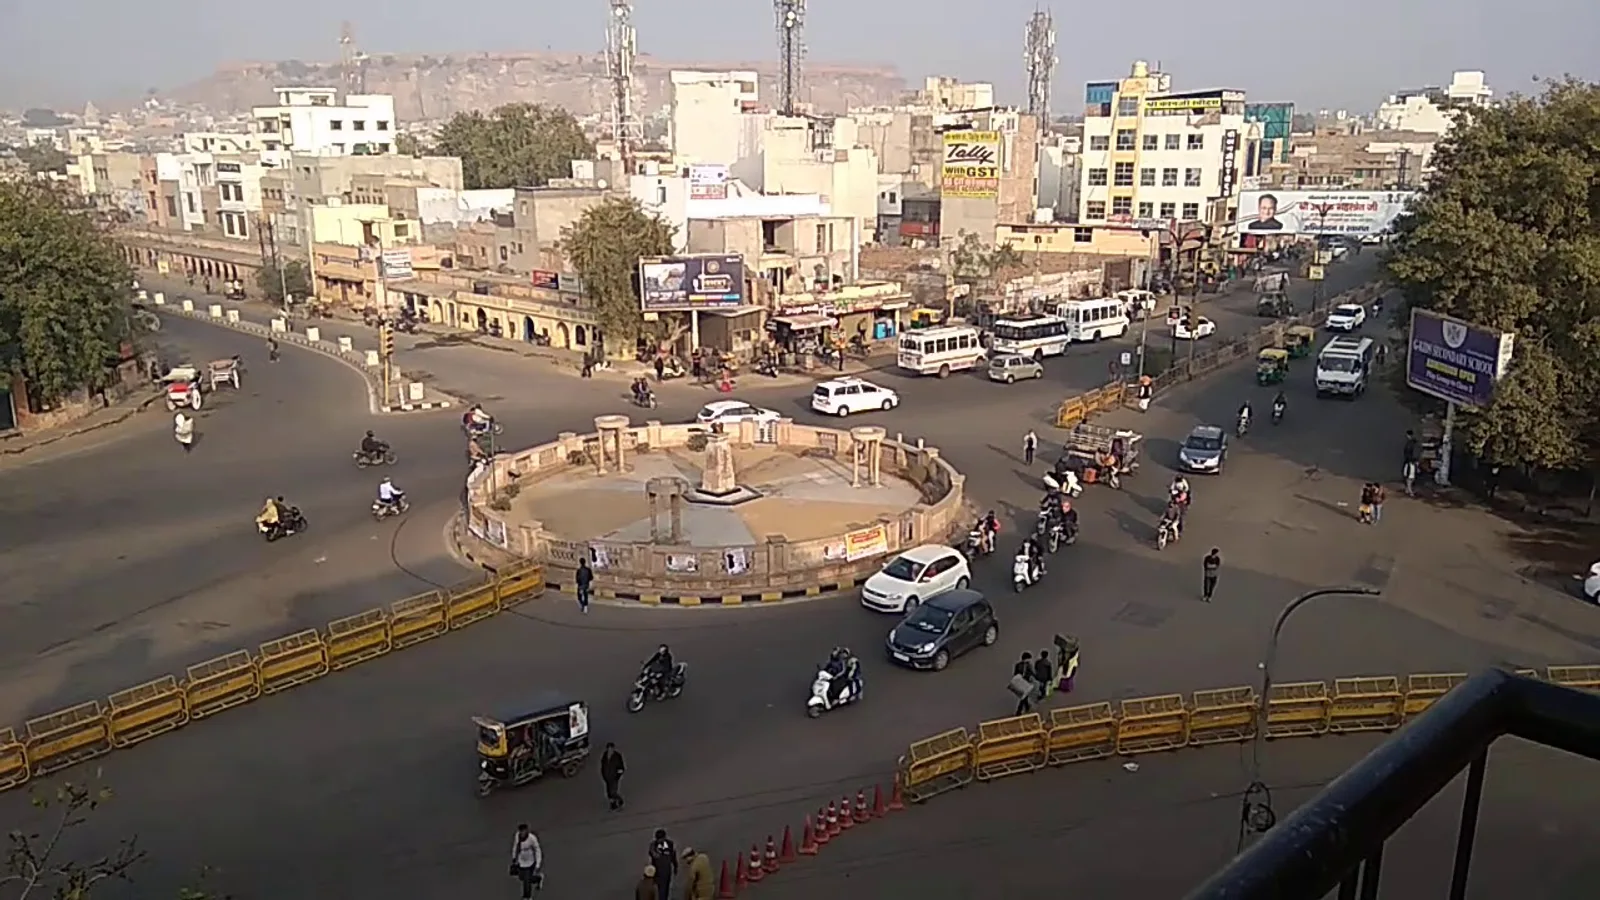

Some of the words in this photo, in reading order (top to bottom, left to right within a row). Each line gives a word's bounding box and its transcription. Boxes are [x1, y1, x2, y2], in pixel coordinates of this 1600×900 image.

[946, 143, 995, 165] Tally
[967, 167, 998, 177] GST
[1432, 345, 1467, 367] SECONDARY
[1467, 356, 1495, 379] SCHOOL
